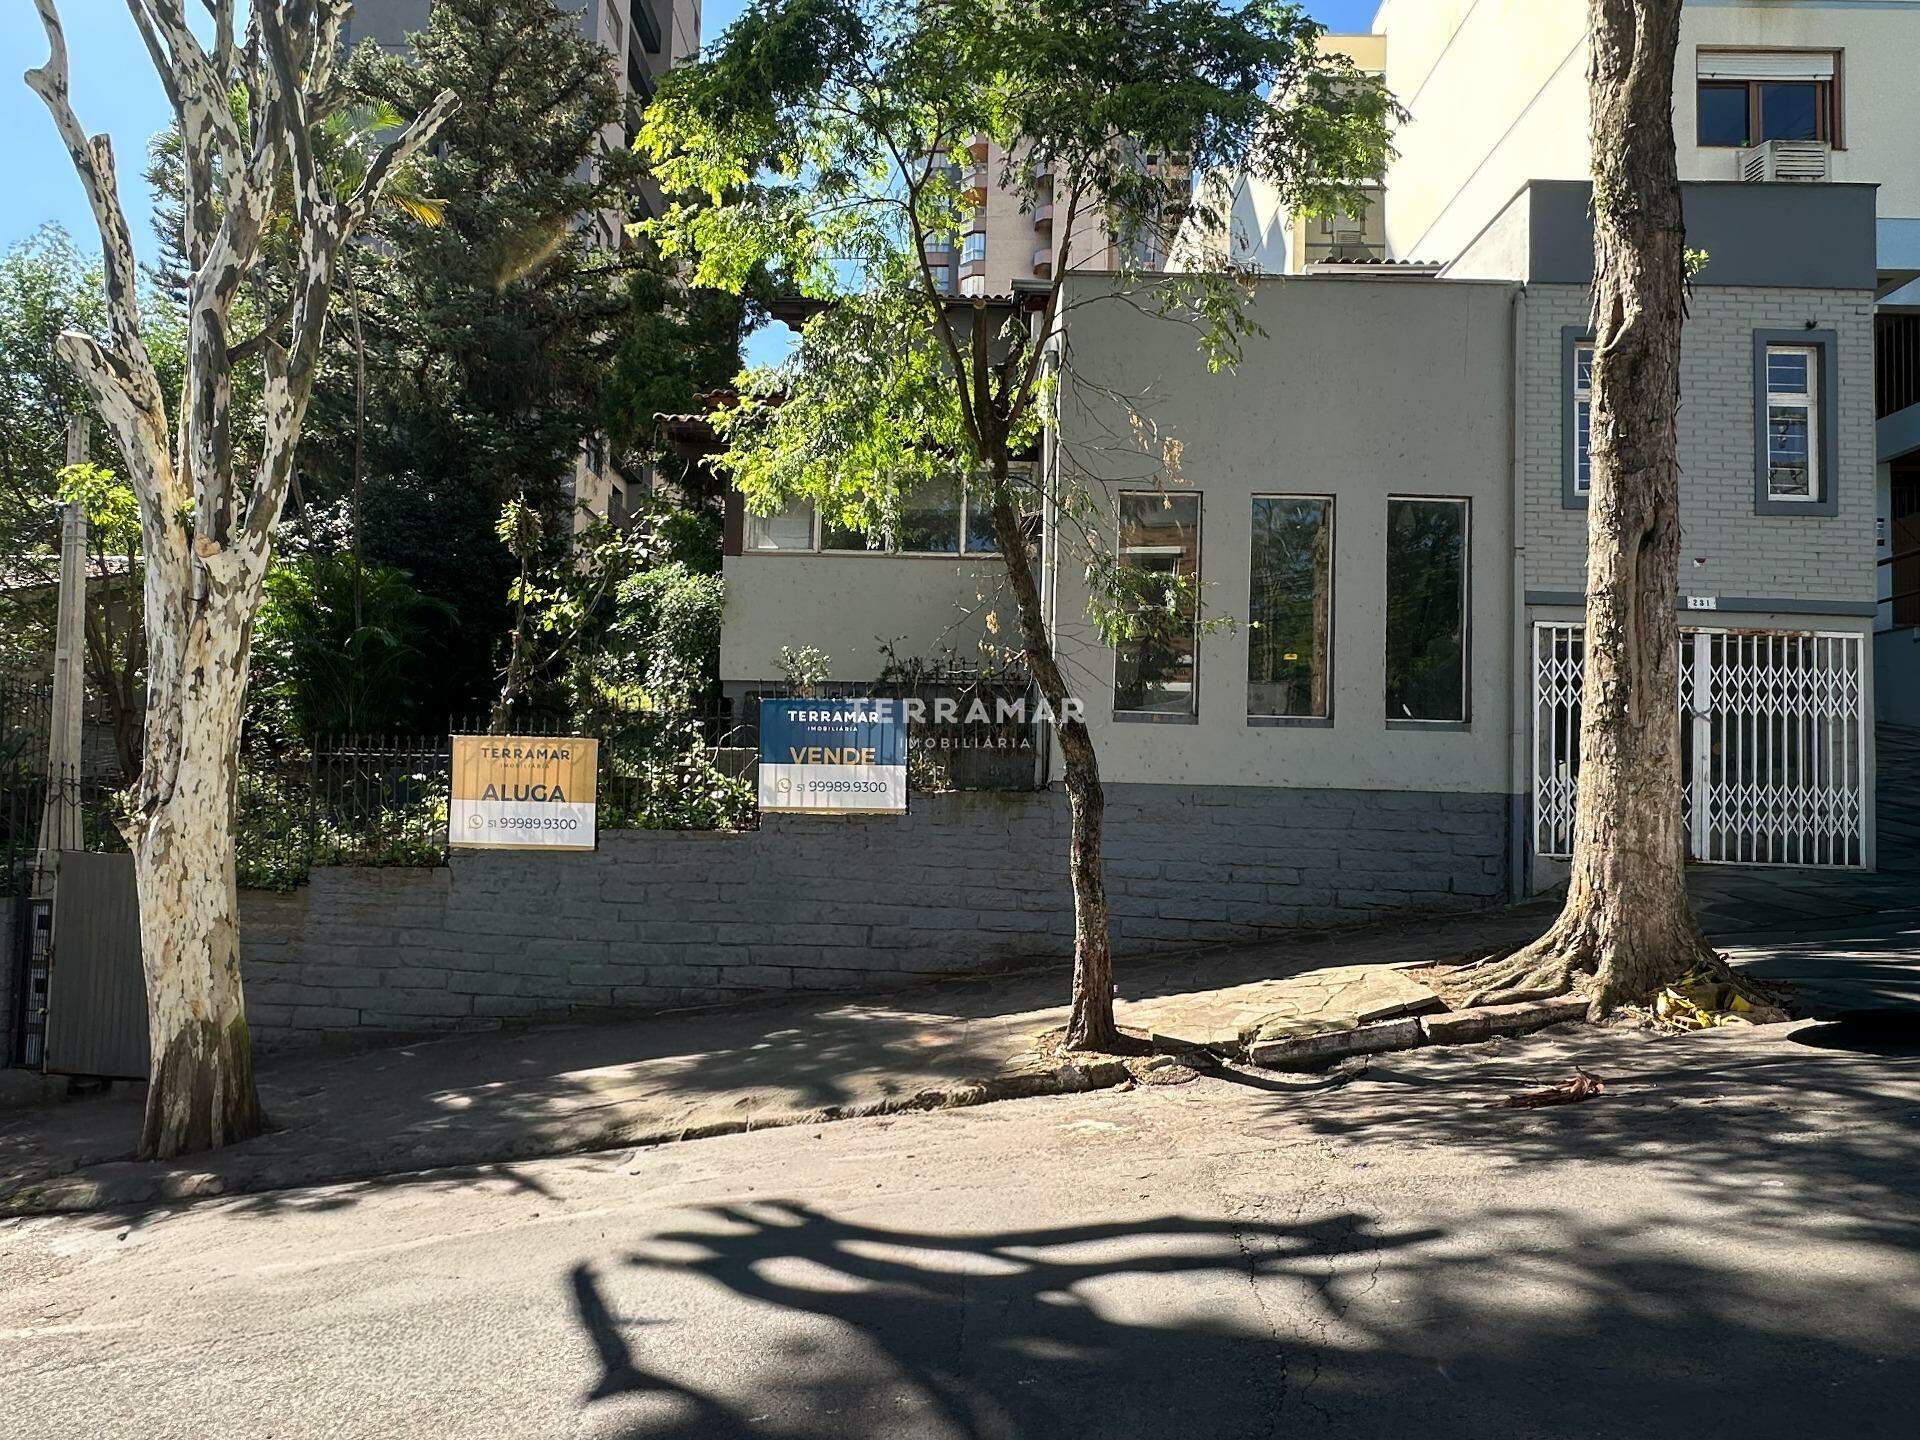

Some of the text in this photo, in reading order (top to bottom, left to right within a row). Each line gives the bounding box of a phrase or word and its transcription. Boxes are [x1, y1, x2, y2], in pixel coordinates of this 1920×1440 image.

[787, 710, 880, 724] TERRAMAR
[482, 748, 570, 760] TERRAMAR
[789, 746, 877, 766] VENDE
[482, 783, 566, 803] ALUGA
[796, 780, 888, 794] 51 99989.9300
[487, 817, 578, 830] 51 99989.9300
